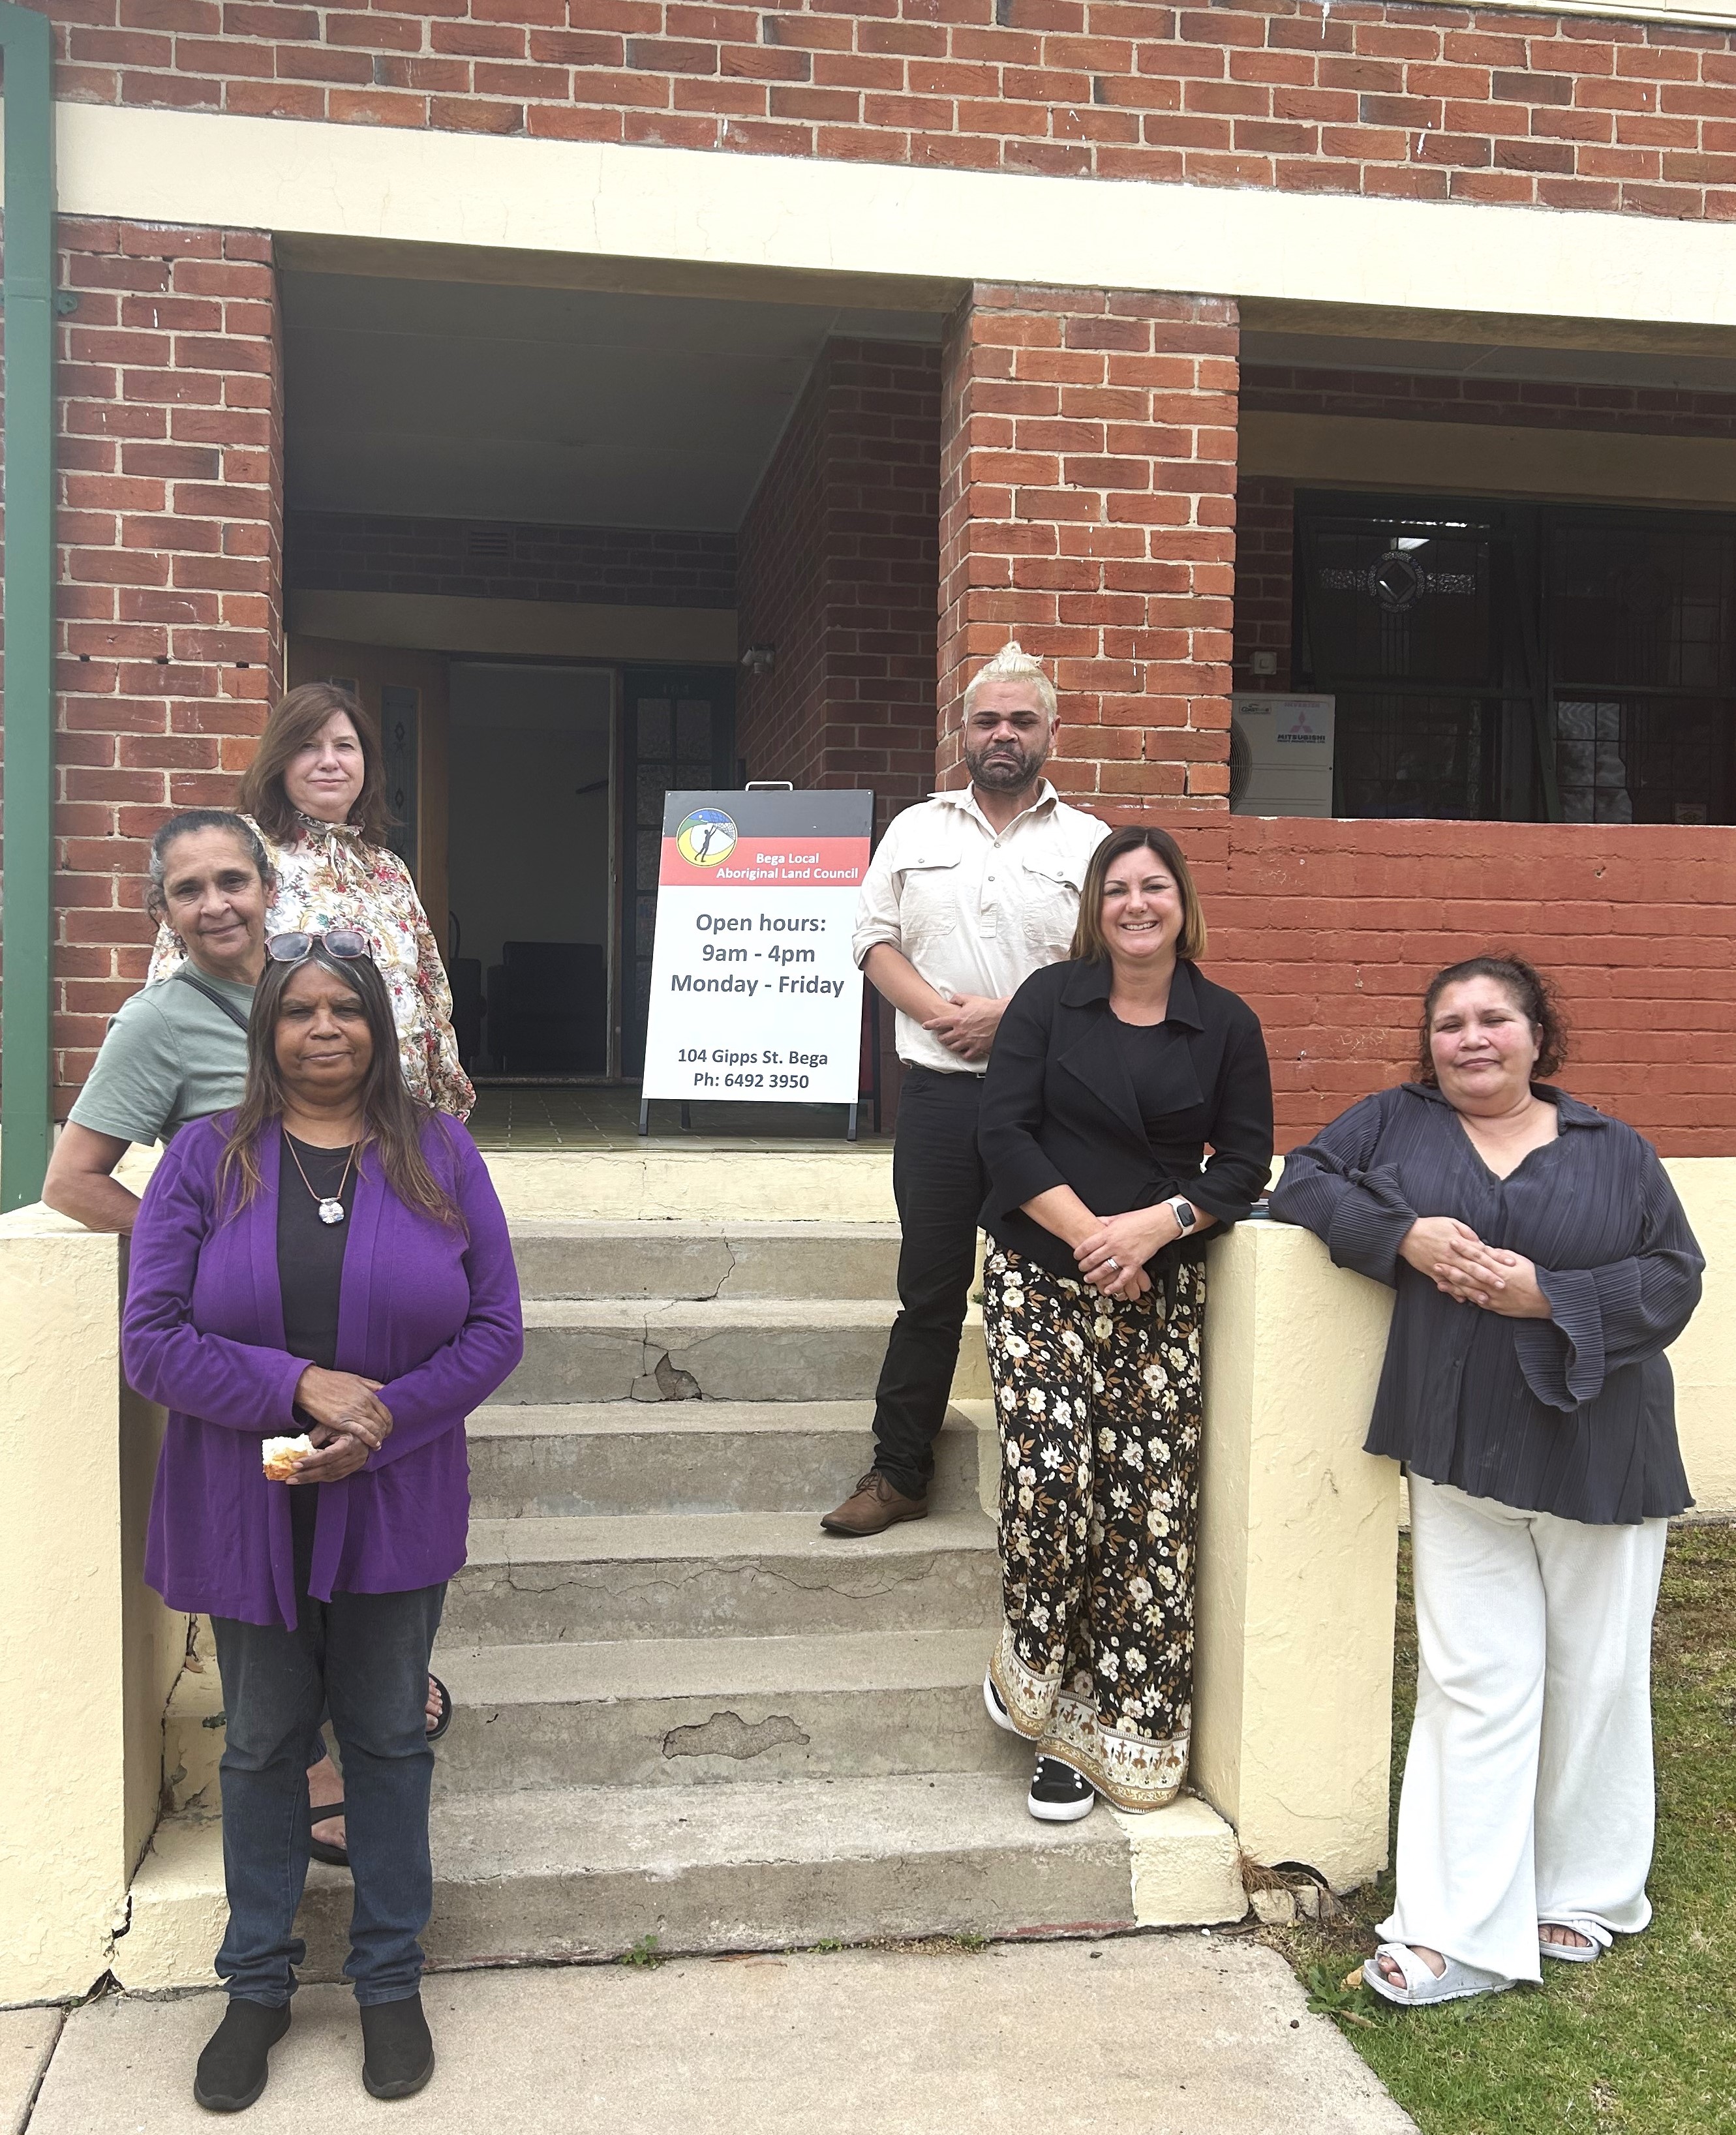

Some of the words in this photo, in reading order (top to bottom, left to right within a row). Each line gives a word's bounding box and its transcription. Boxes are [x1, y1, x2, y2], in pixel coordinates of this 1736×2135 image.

[756, 853, 785, 866] Bega
[788, 852, 819, 864] Local
[716, 867, 779, 881] Aboriginal
[782, 867, 811, 879] Land
[813, 867, 859, 879] Council
[696, 914, 752, 935] Open
[759, 913, 826, 931] hours:
[703, 944, 748, 962] 9am
[768, 945, 815, 967] 4pm
[671, 974, 759, 997] Monday
[779, 975, 845, 998] Friday
[678, 1048, 707, 1063] 104
[712, 1049, 757, 1067] Gipps
[762, 1050, 783, 1064] St.
[789, 1051, 828, 1068] Bega
[693, 1072, 720, 1087] Ph:
[724, 1073, 764, 1087] 6492
[769, 1074, 809, 1089] 3950
